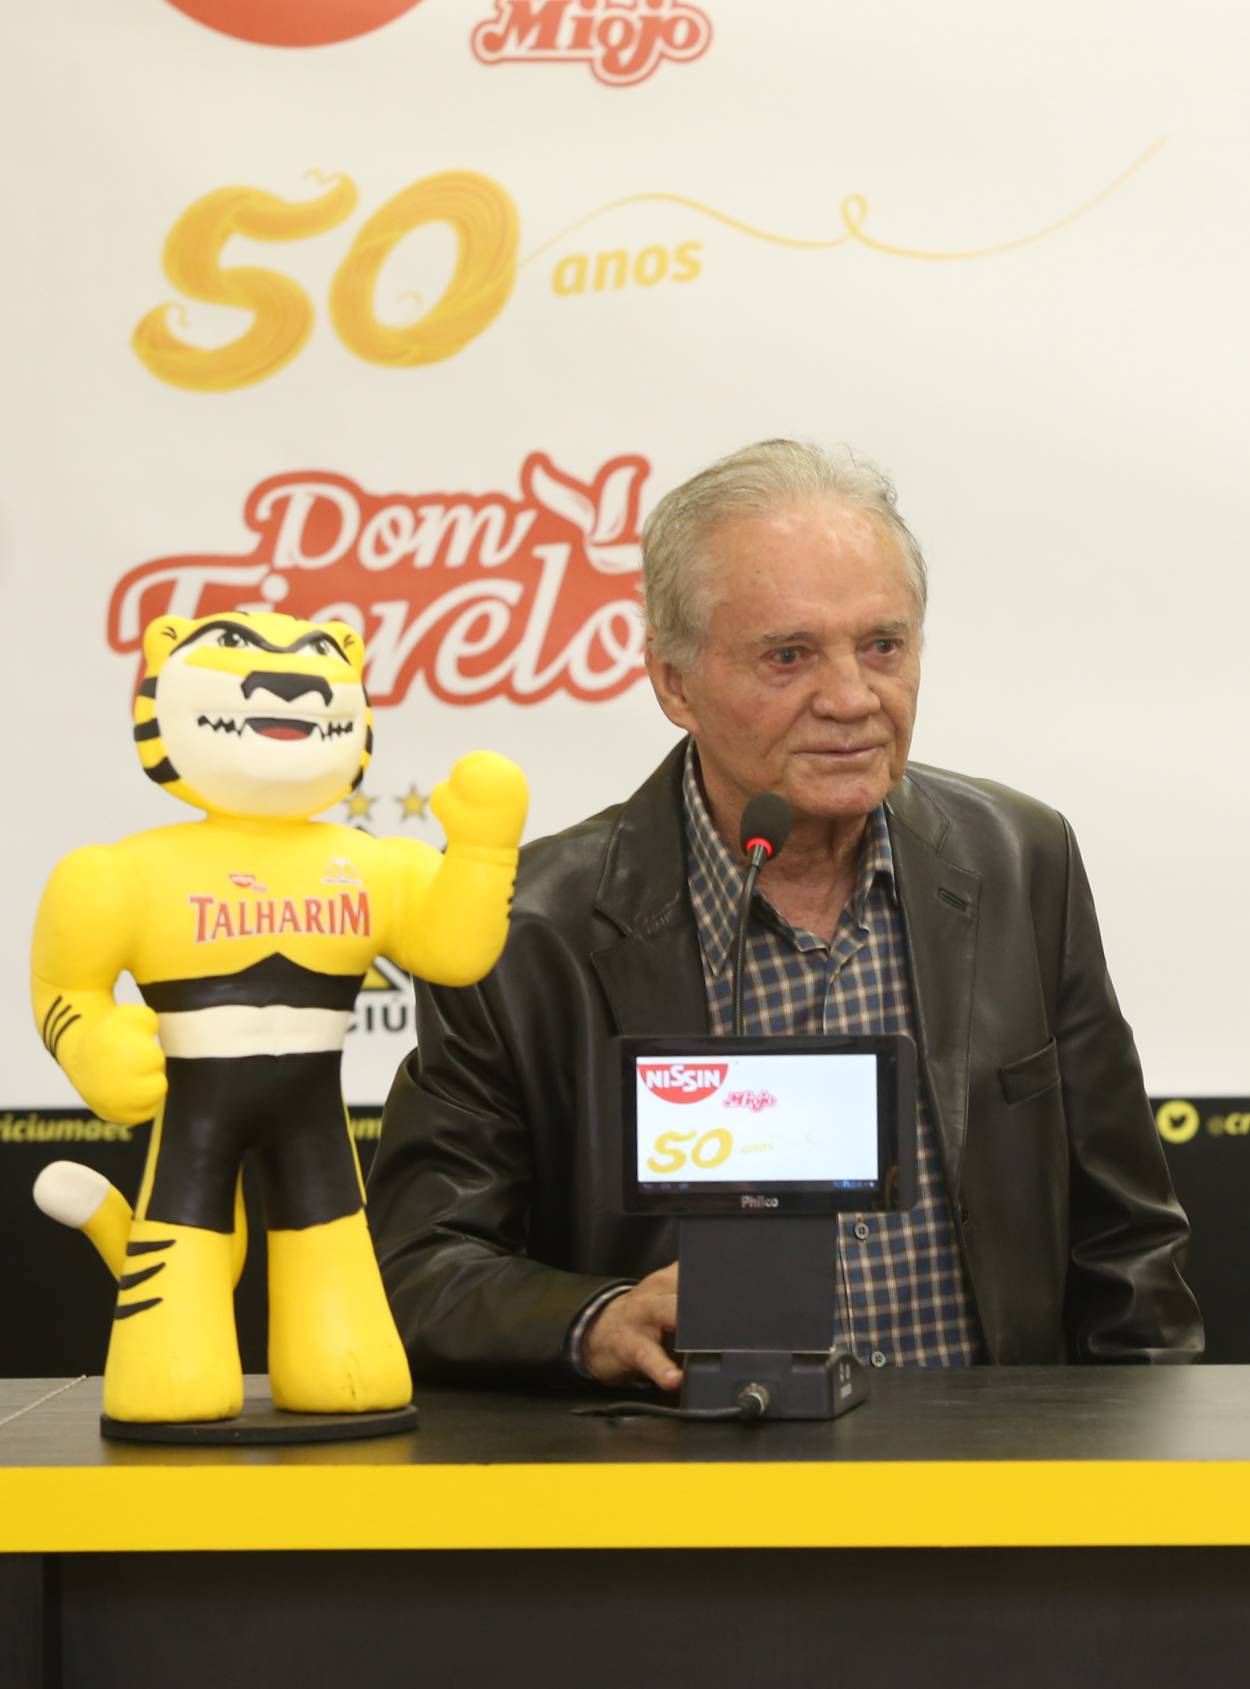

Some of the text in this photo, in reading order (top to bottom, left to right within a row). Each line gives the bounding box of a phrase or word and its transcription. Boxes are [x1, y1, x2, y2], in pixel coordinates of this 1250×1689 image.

[478, 0, 704, 78] Miojo
[130, 168, 704, 393] 50 anos
[254, 486, 539, 571] Dom
[189, 891, 371, 944] TALHARIM
[645, 1064, 721, 1093] NISSIN
[0, 1112, 133, 1141] iciumaec
[647, 1128, 733, 1174] 50
[741, 1196, 779, 1208] Philco
